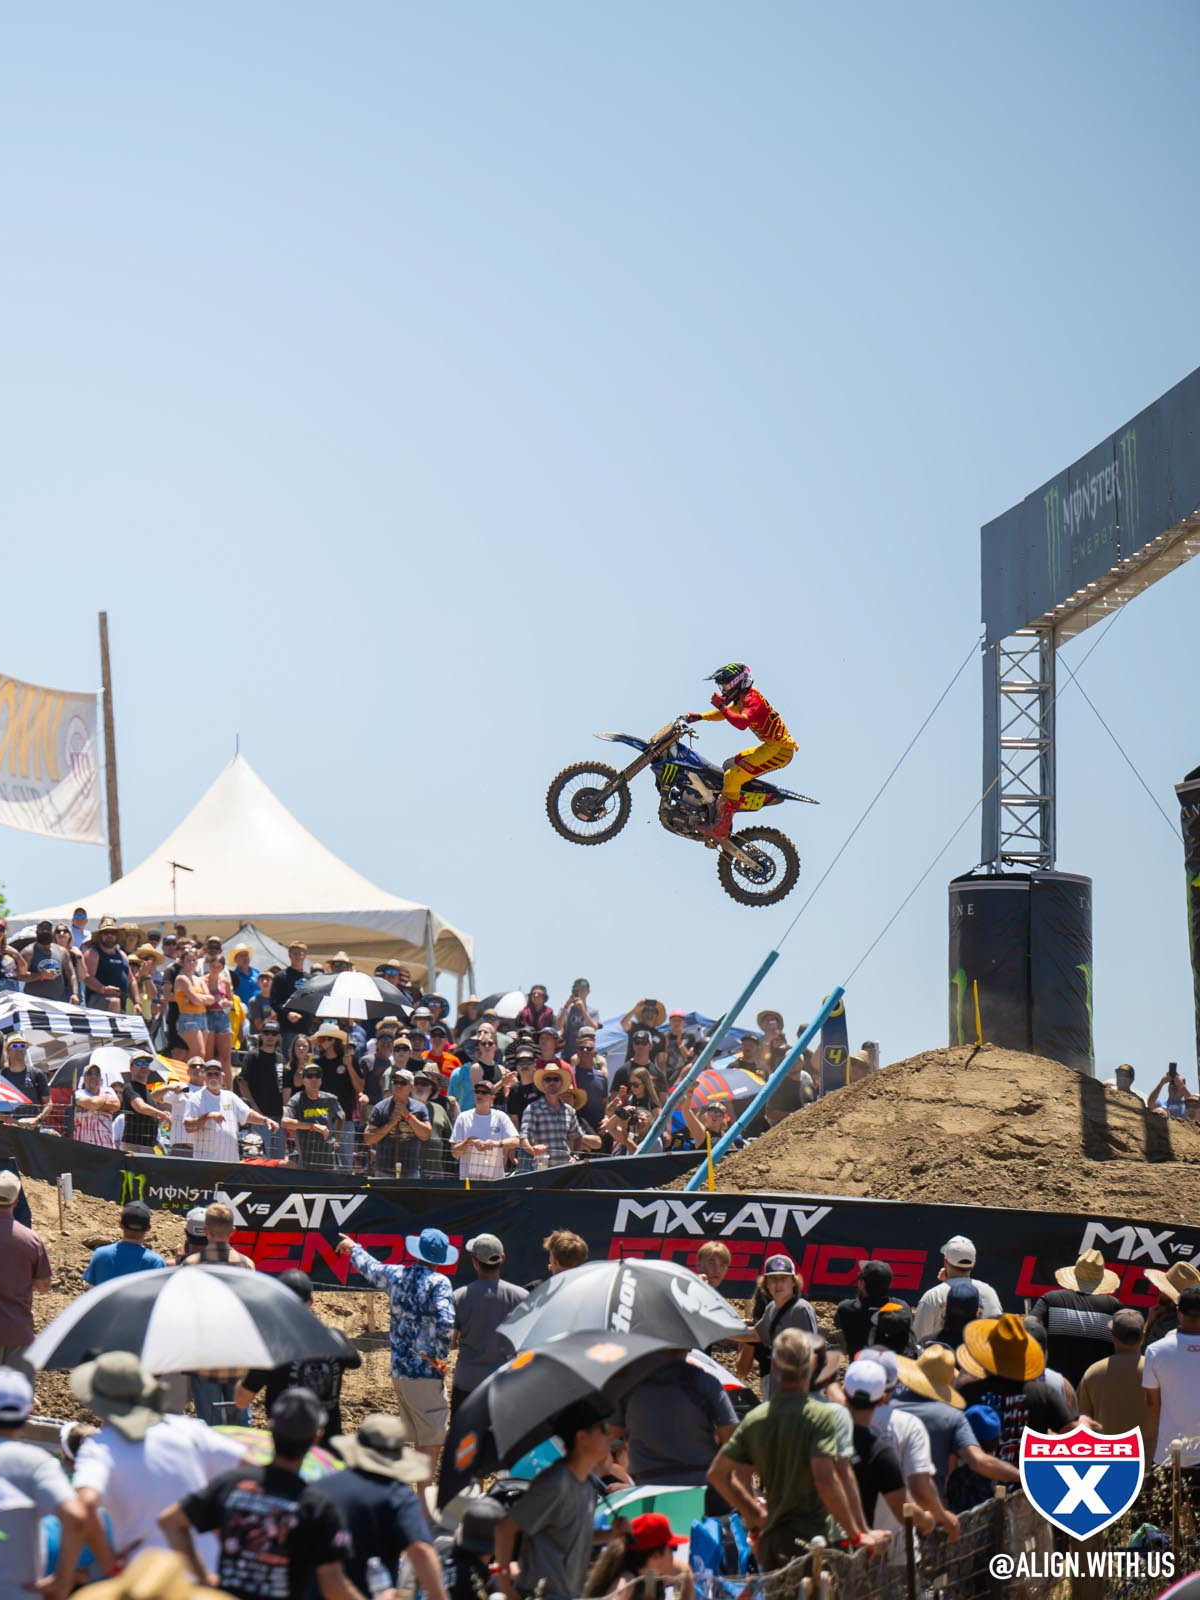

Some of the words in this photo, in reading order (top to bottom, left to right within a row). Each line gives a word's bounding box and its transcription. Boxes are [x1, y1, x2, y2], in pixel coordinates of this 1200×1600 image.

[1062, 459, 1122, 537] MONSTER
[738, 791, 766, 810] 38
[828, 1048, 843, 1064] 4
[263, 1193, 368, 1229] ATV
[612, 1199, 707, 1236] MX
[702, 1211, 727, 1224] VS
[719, 1202, 833, 1238] ATV
[1078, 1221, 1176, 1266] MX
[611, 1269, 637, 1334] hor
